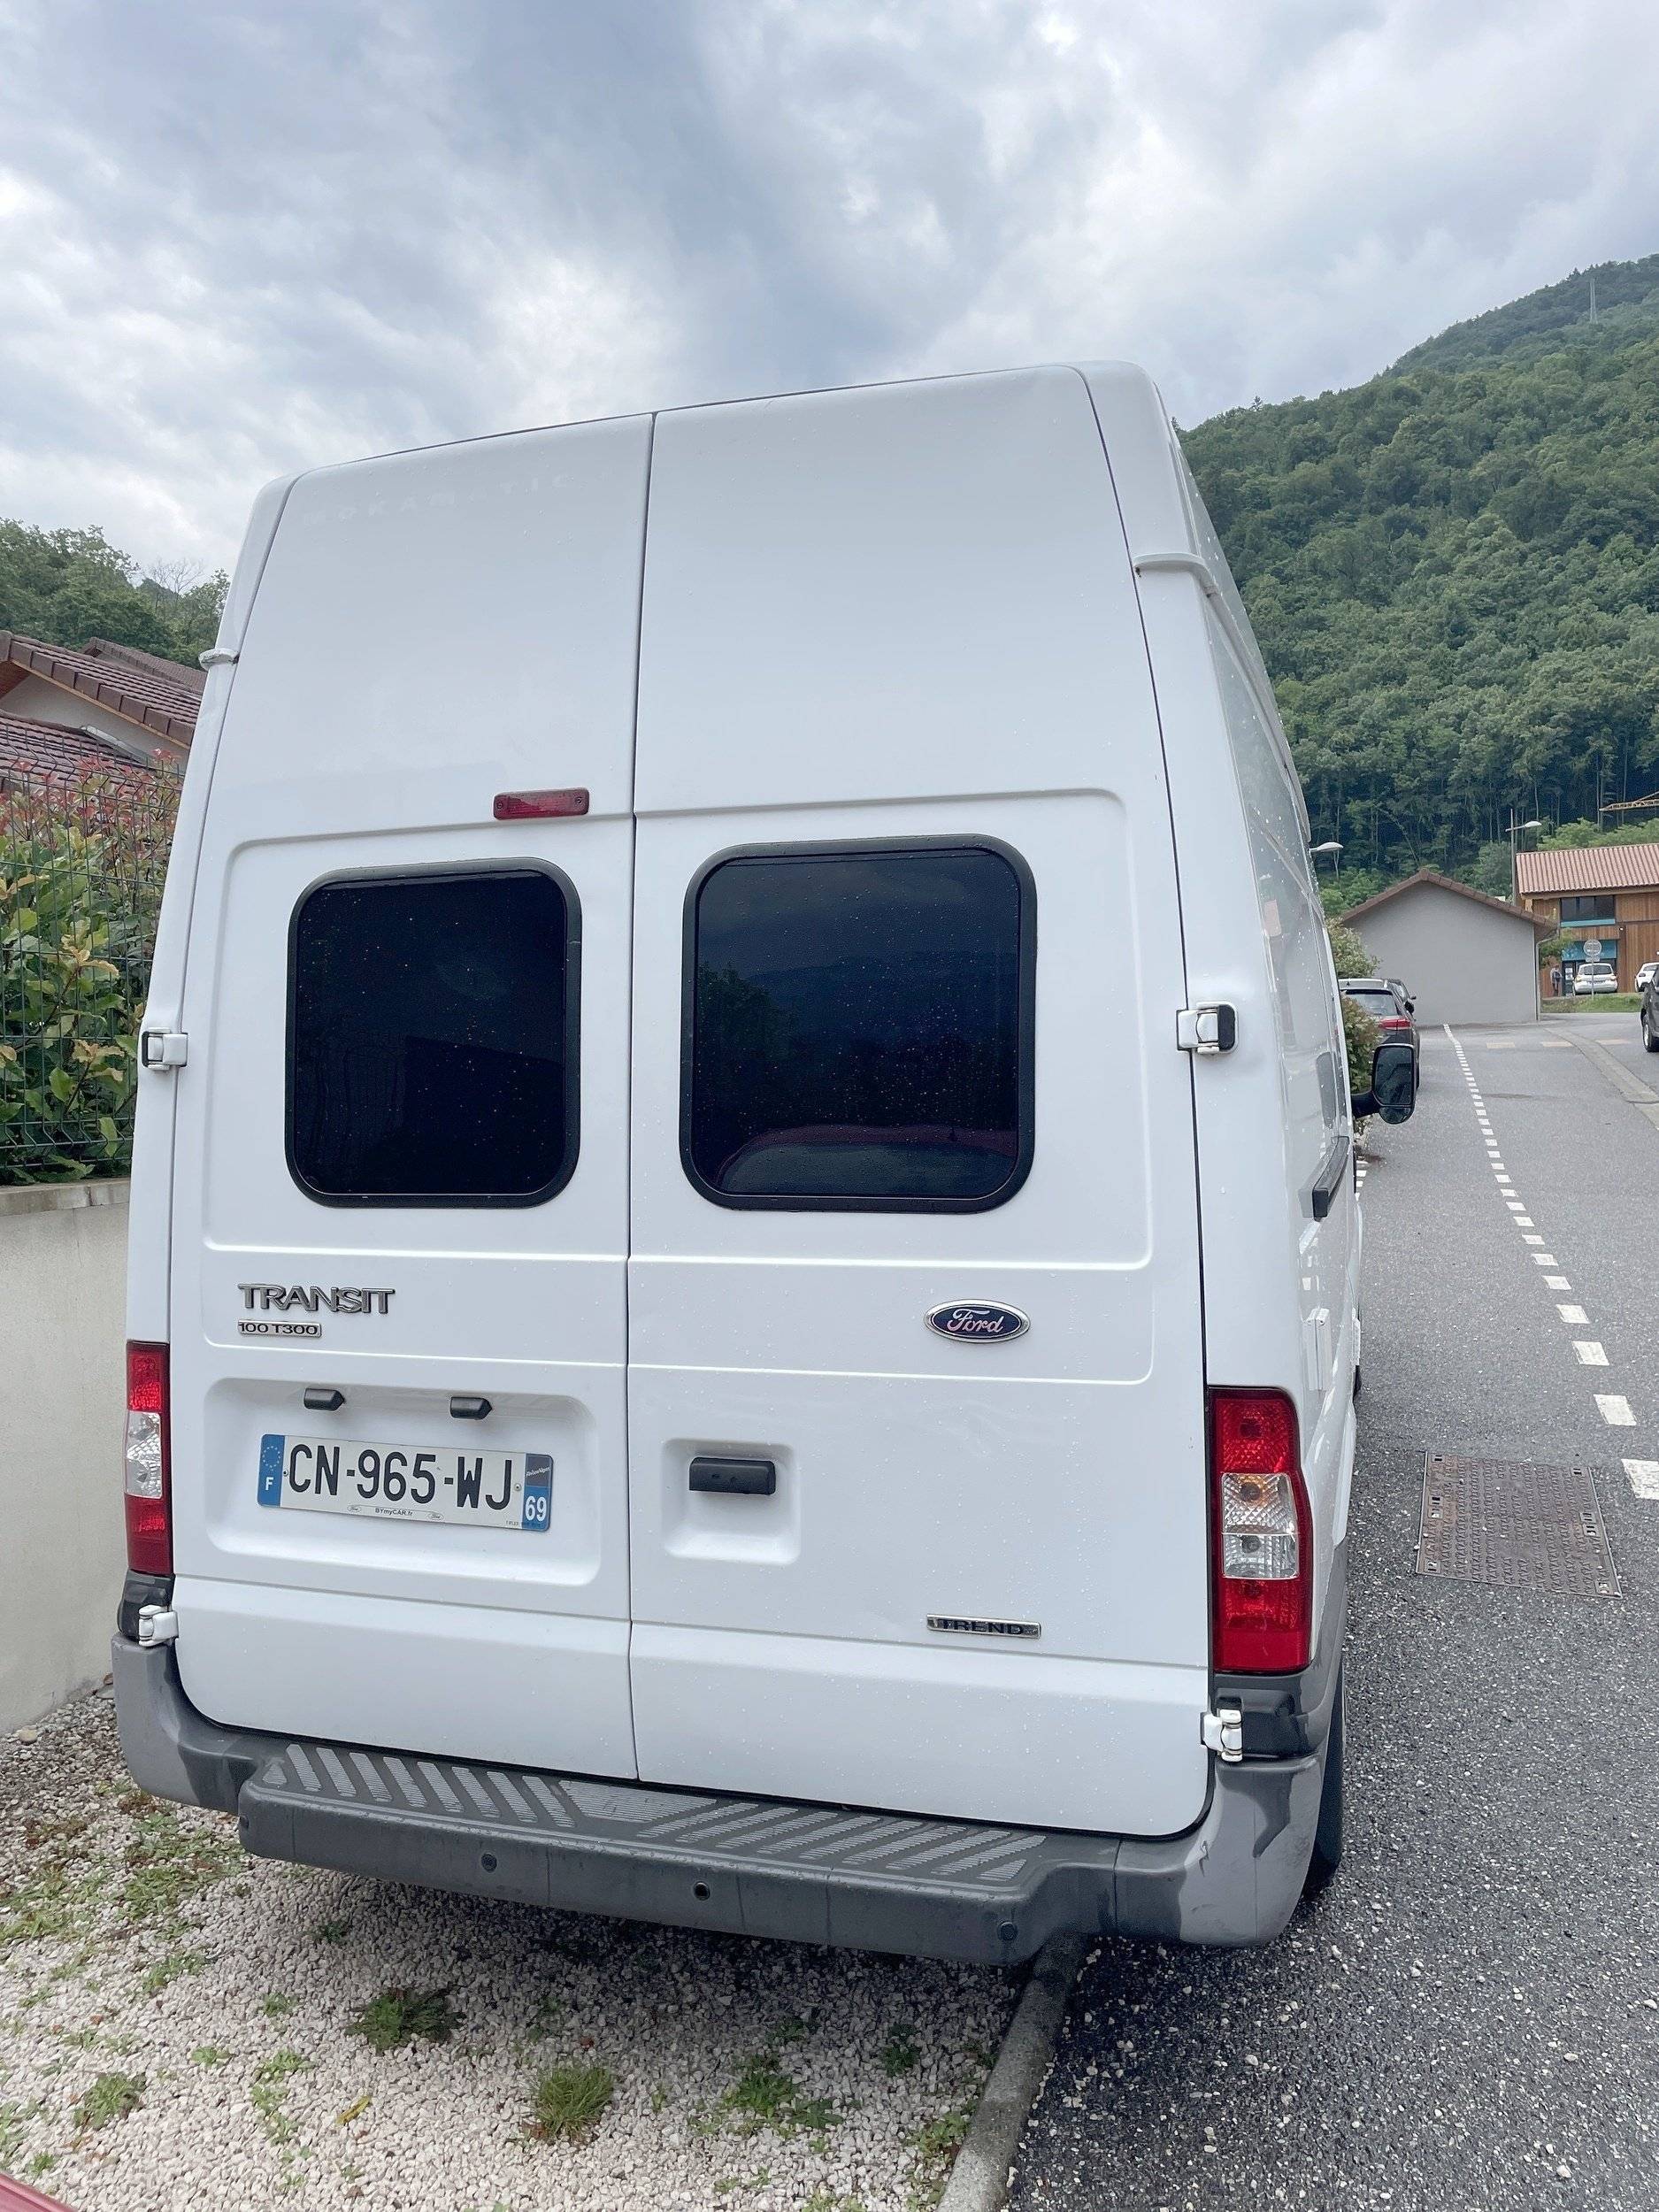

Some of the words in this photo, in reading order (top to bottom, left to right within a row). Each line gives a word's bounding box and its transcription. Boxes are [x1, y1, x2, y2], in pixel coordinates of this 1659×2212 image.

[237, 1283, 396, 1314] TRANSIT
[239, 1322, 268, 1333] 100
[272, 1324, 318, 1334] T300
[947, 1309, 1004, 1333] Ford
[265, 1477, 274, 1491] F
[288, 1443, 512, 1510] CN-965-WJ
[525, 1495, 547, 1522] 69
[937, 1618, 1024, 1635] TREND
